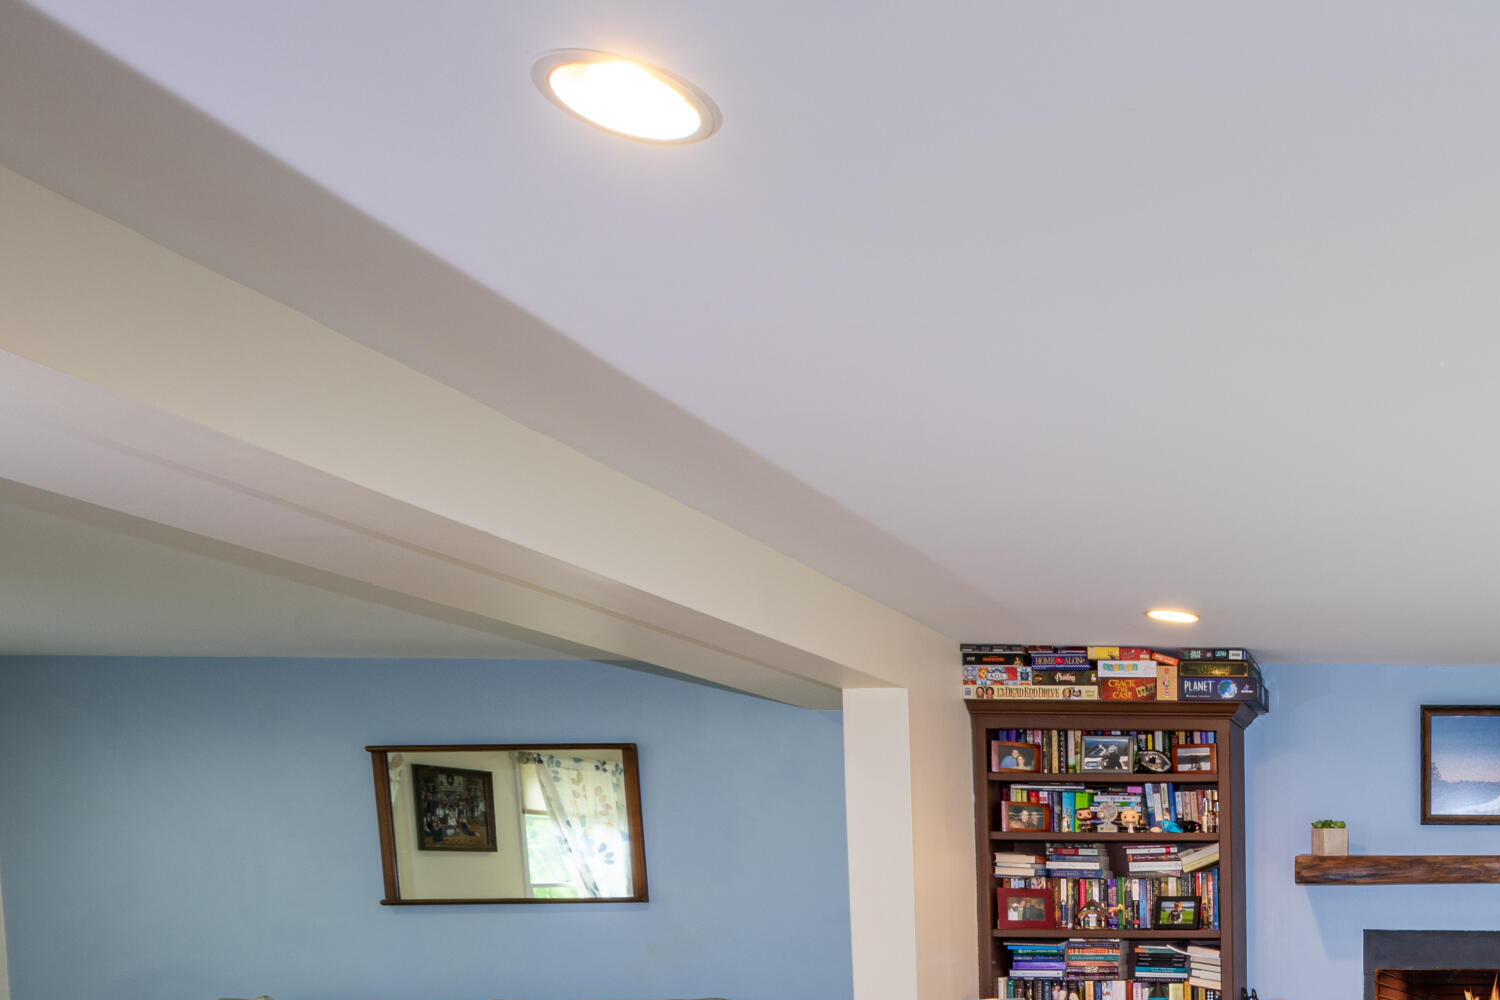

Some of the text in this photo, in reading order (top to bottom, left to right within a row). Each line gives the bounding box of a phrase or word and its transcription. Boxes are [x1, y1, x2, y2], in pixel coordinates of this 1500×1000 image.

[1108, 679, 1136, 688] CRACK
[1184, 680, 1216, 694] PLANET
[1112, 691, 1133, 699] CASE
